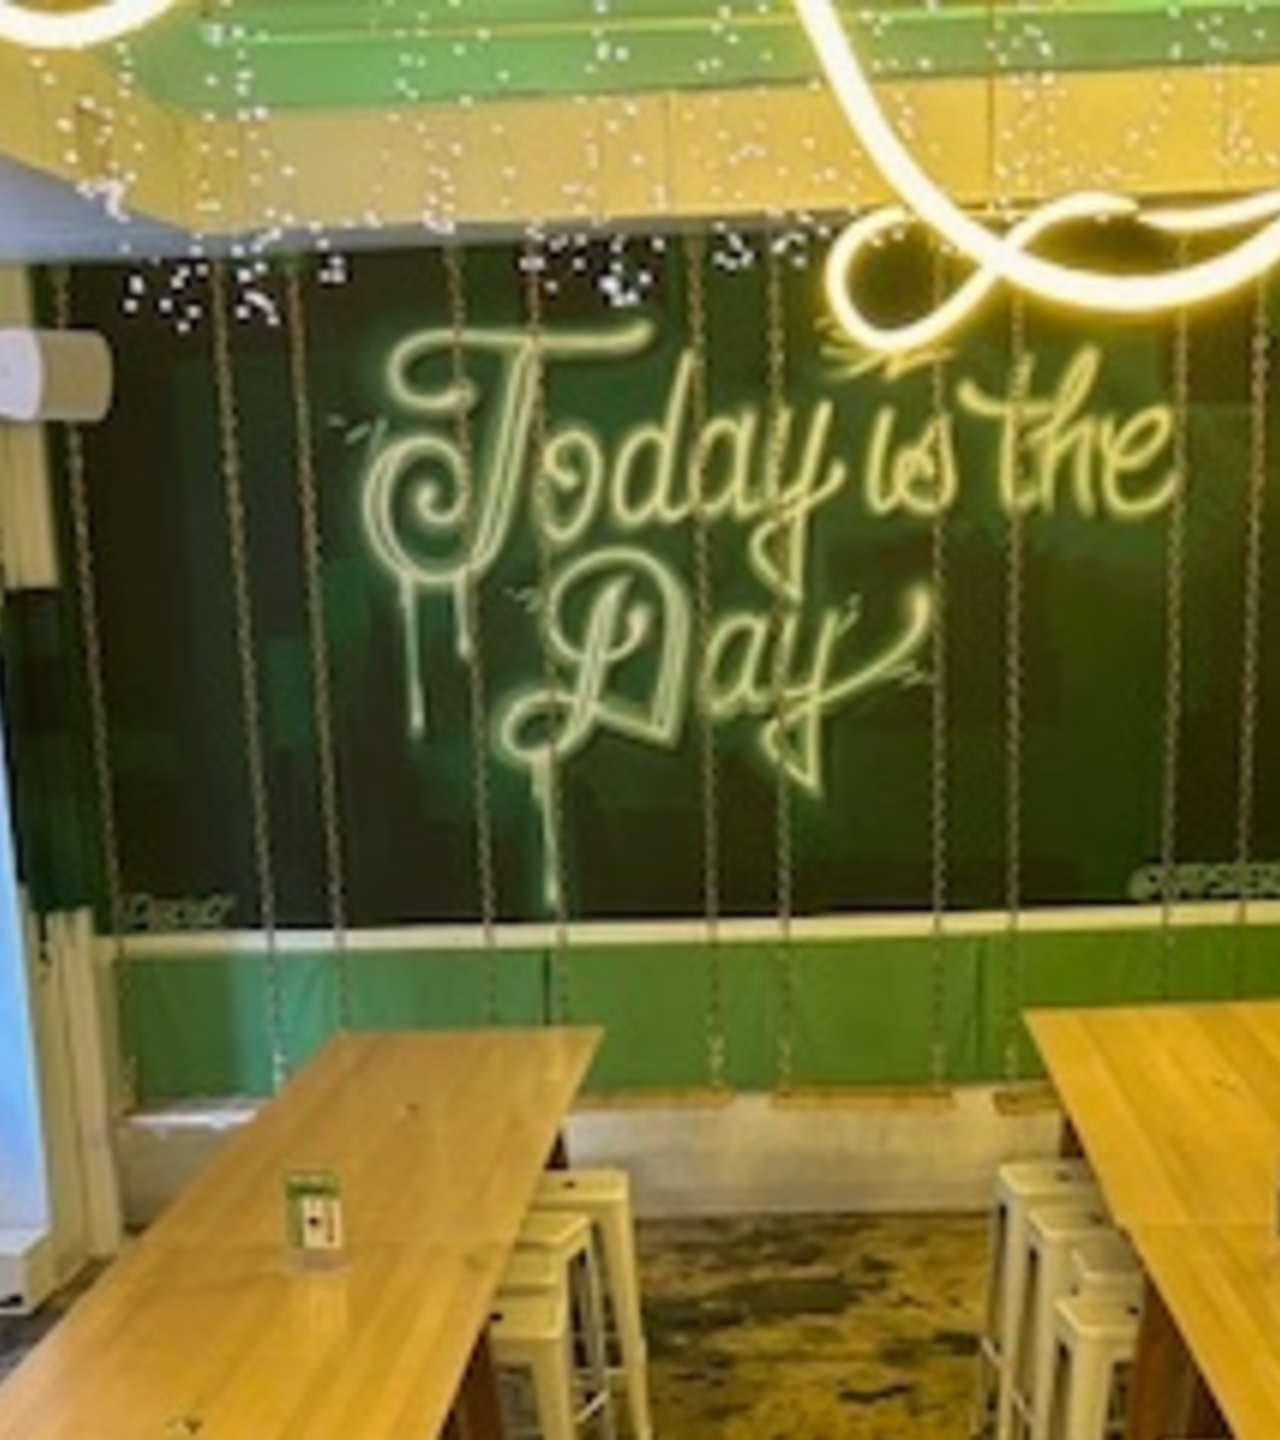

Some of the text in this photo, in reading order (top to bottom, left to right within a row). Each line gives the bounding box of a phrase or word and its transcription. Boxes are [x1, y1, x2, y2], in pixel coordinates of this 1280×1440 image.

[360, 319, 1184, 598] Today is the
[498, 546, 934, 798] Day
